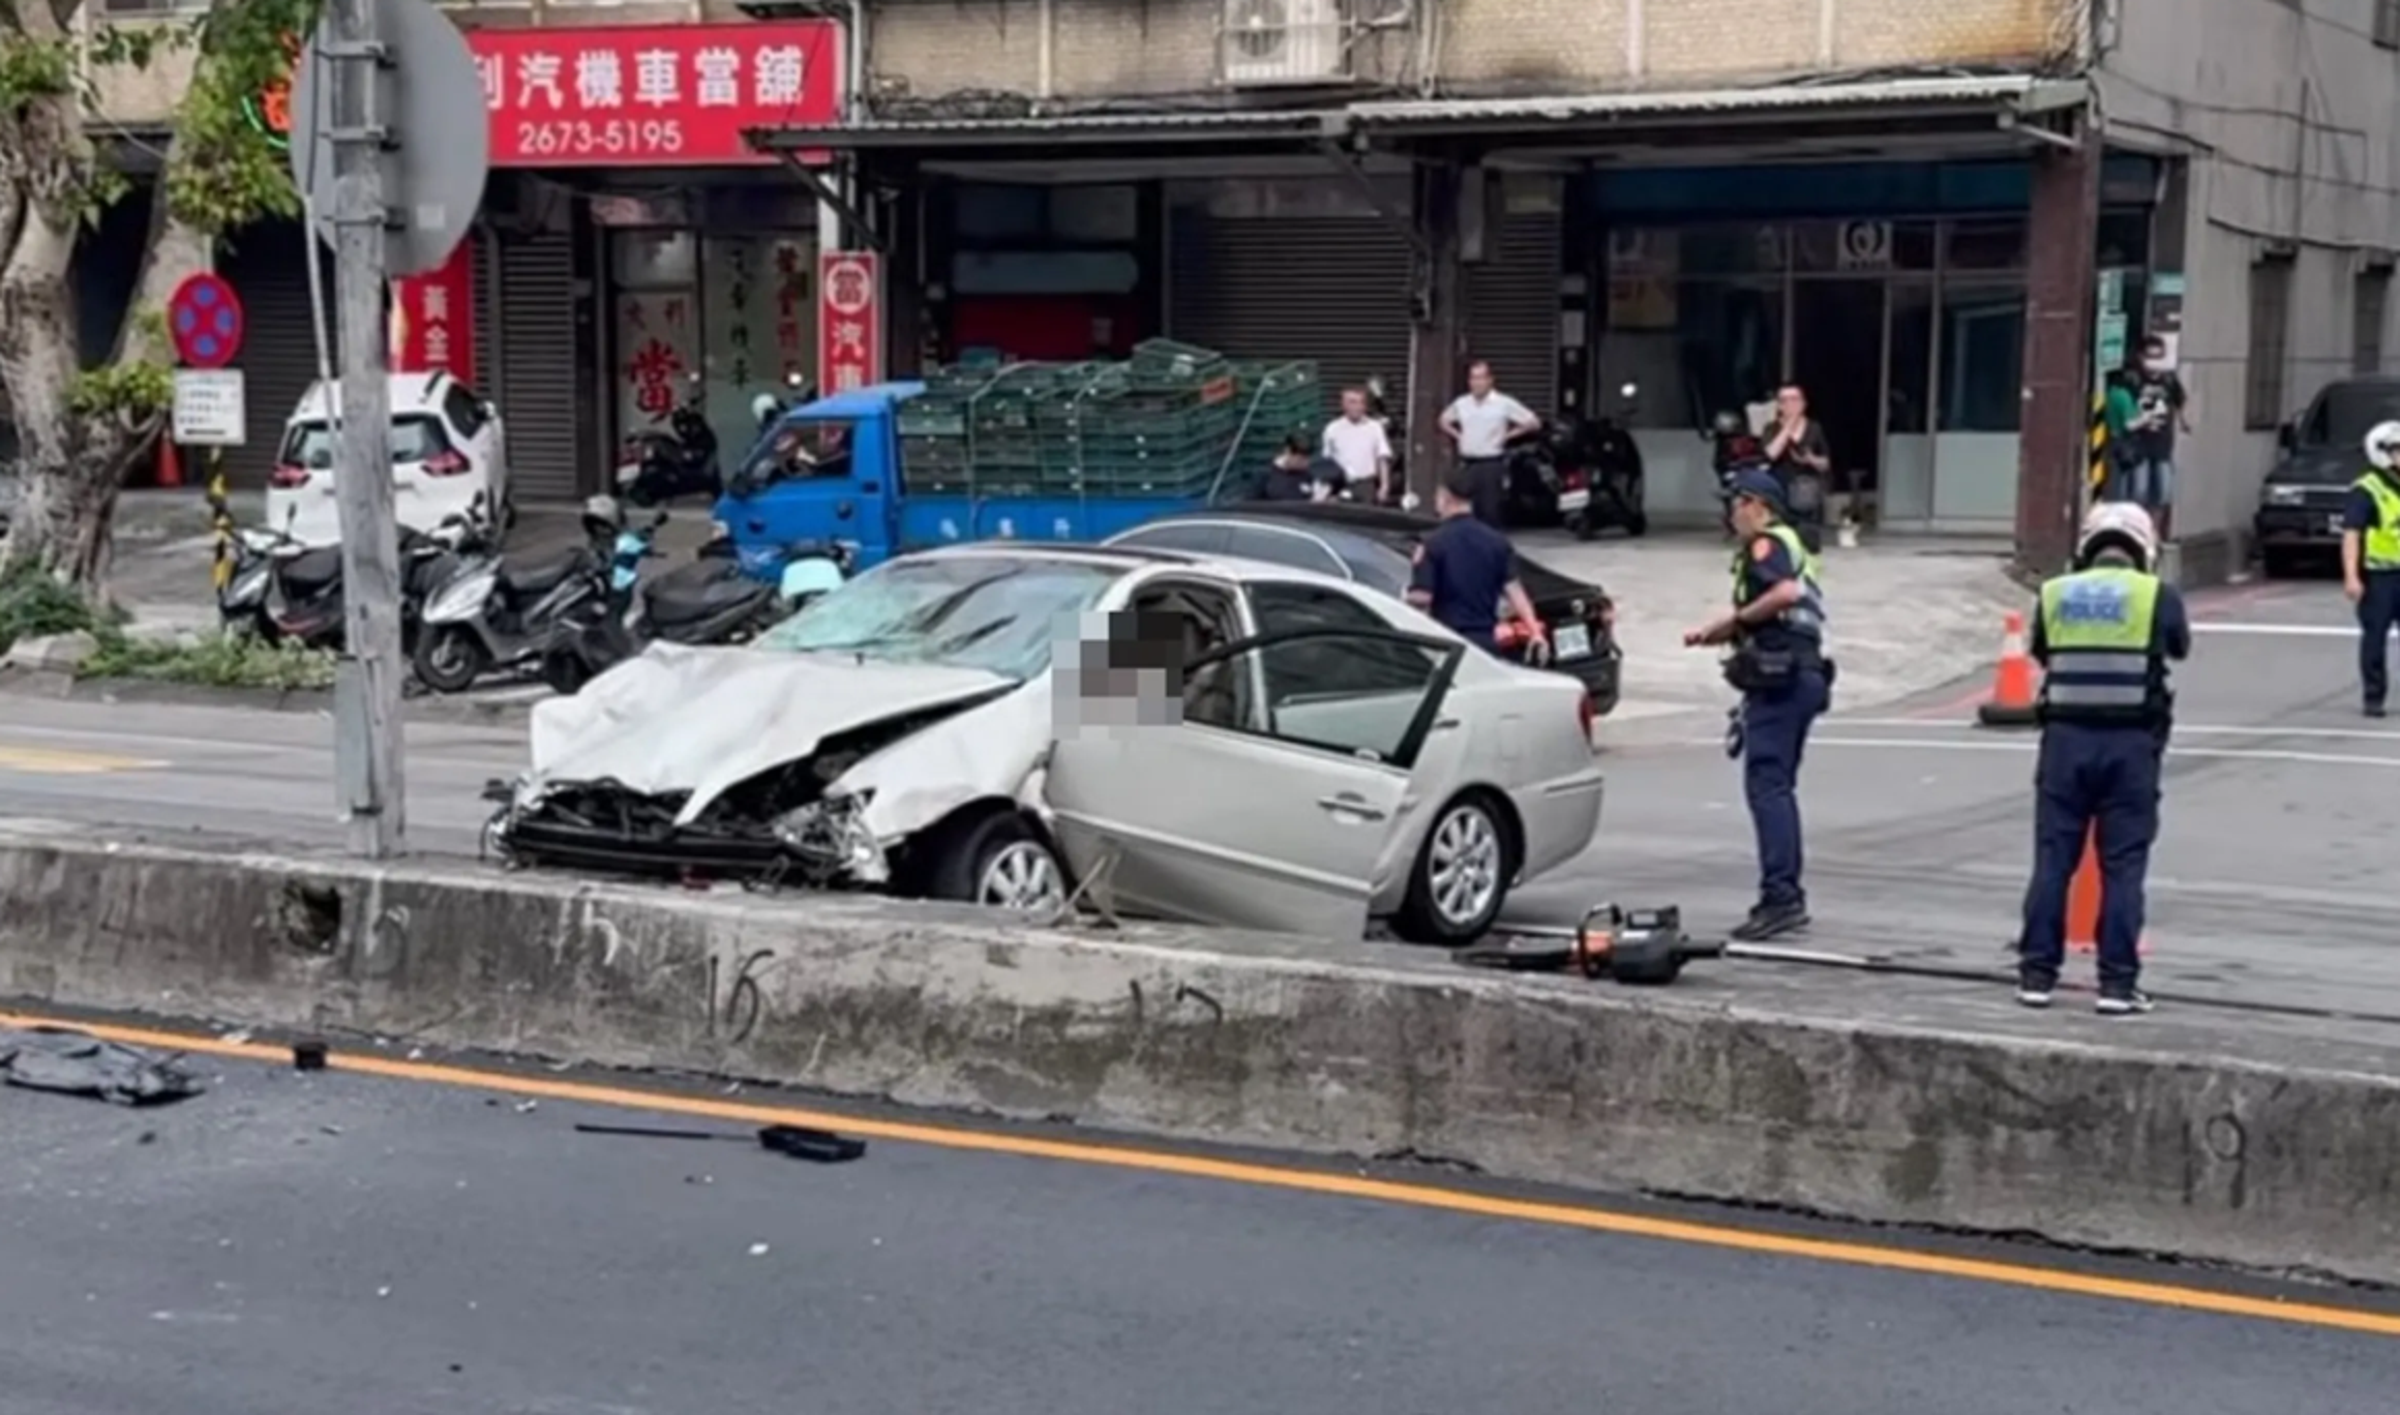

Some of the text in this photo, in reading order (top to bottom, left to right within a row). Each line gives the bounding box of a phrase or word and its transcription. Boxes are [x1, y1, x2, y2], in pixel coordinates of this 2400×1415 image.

[518, 120, 682, 153] 2673-5195
[2058, 599, 2124, 620] POLICE
[707, 949, 776, 1044] 16
